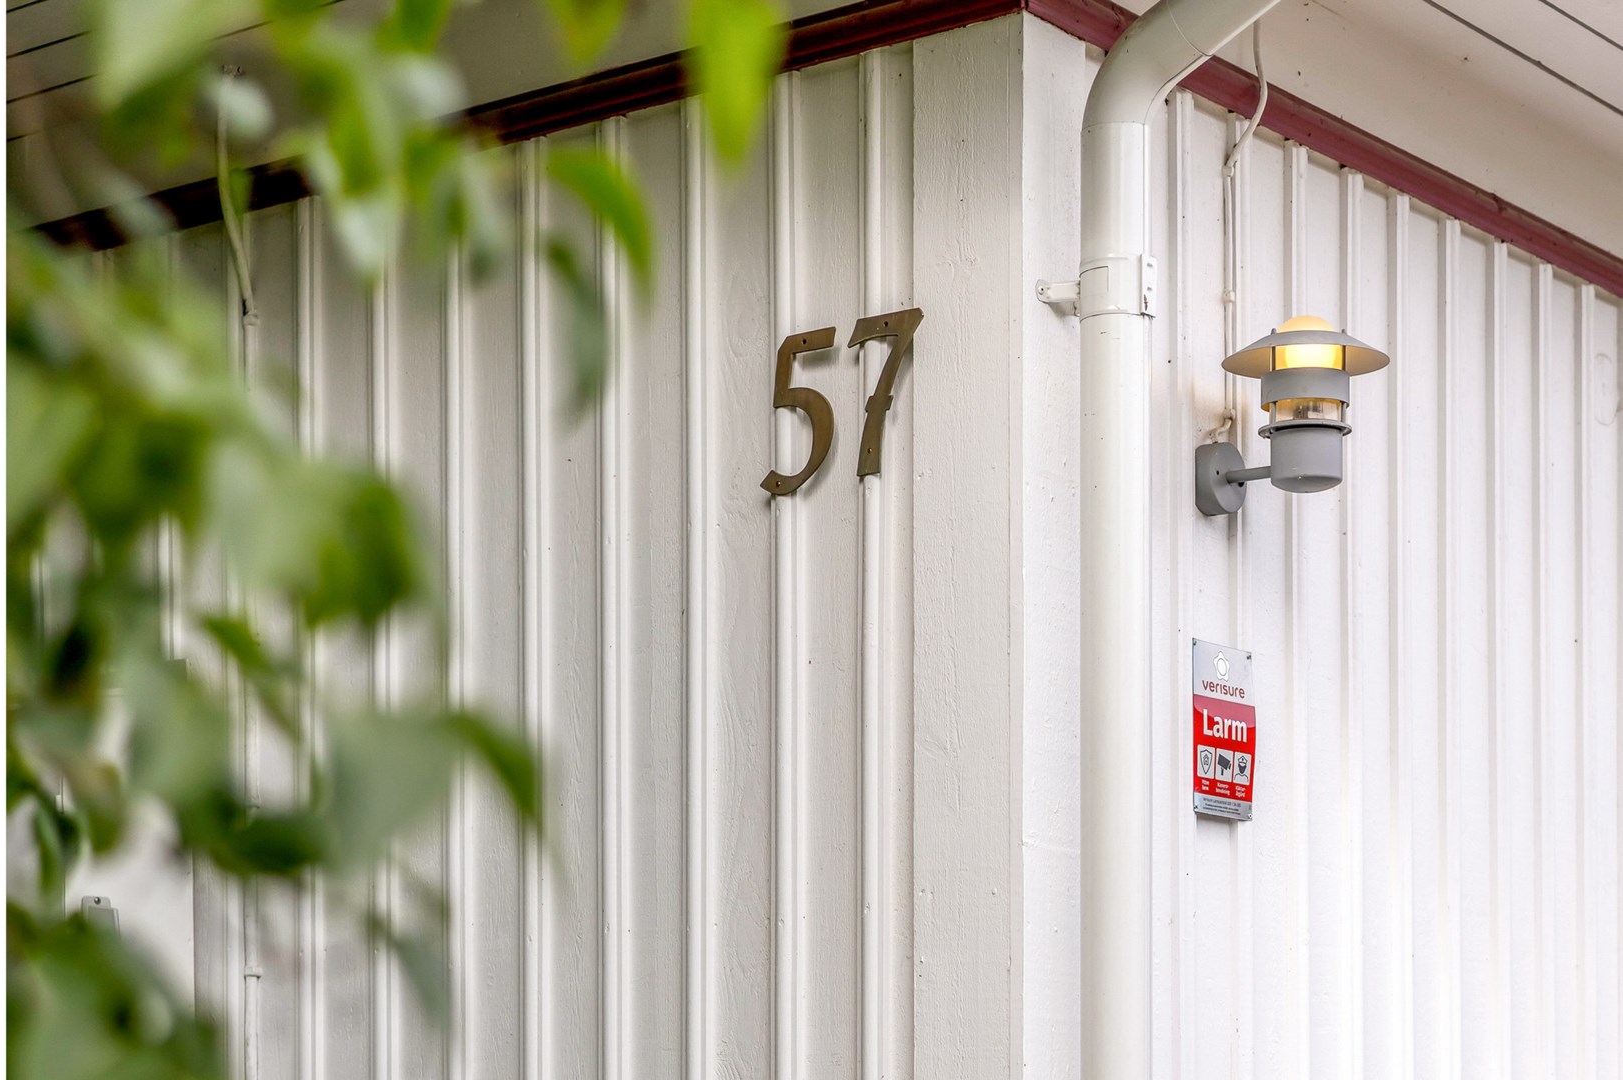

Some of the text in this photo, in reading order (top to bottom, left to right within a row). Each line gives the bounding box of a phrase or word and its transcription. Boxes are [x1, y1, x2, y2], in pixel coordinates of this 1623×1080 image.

[760, 307, 924, 495] 57
[1202, 680, 1245, 699] verisure
[1203, 708, 1247, 743] Larm
